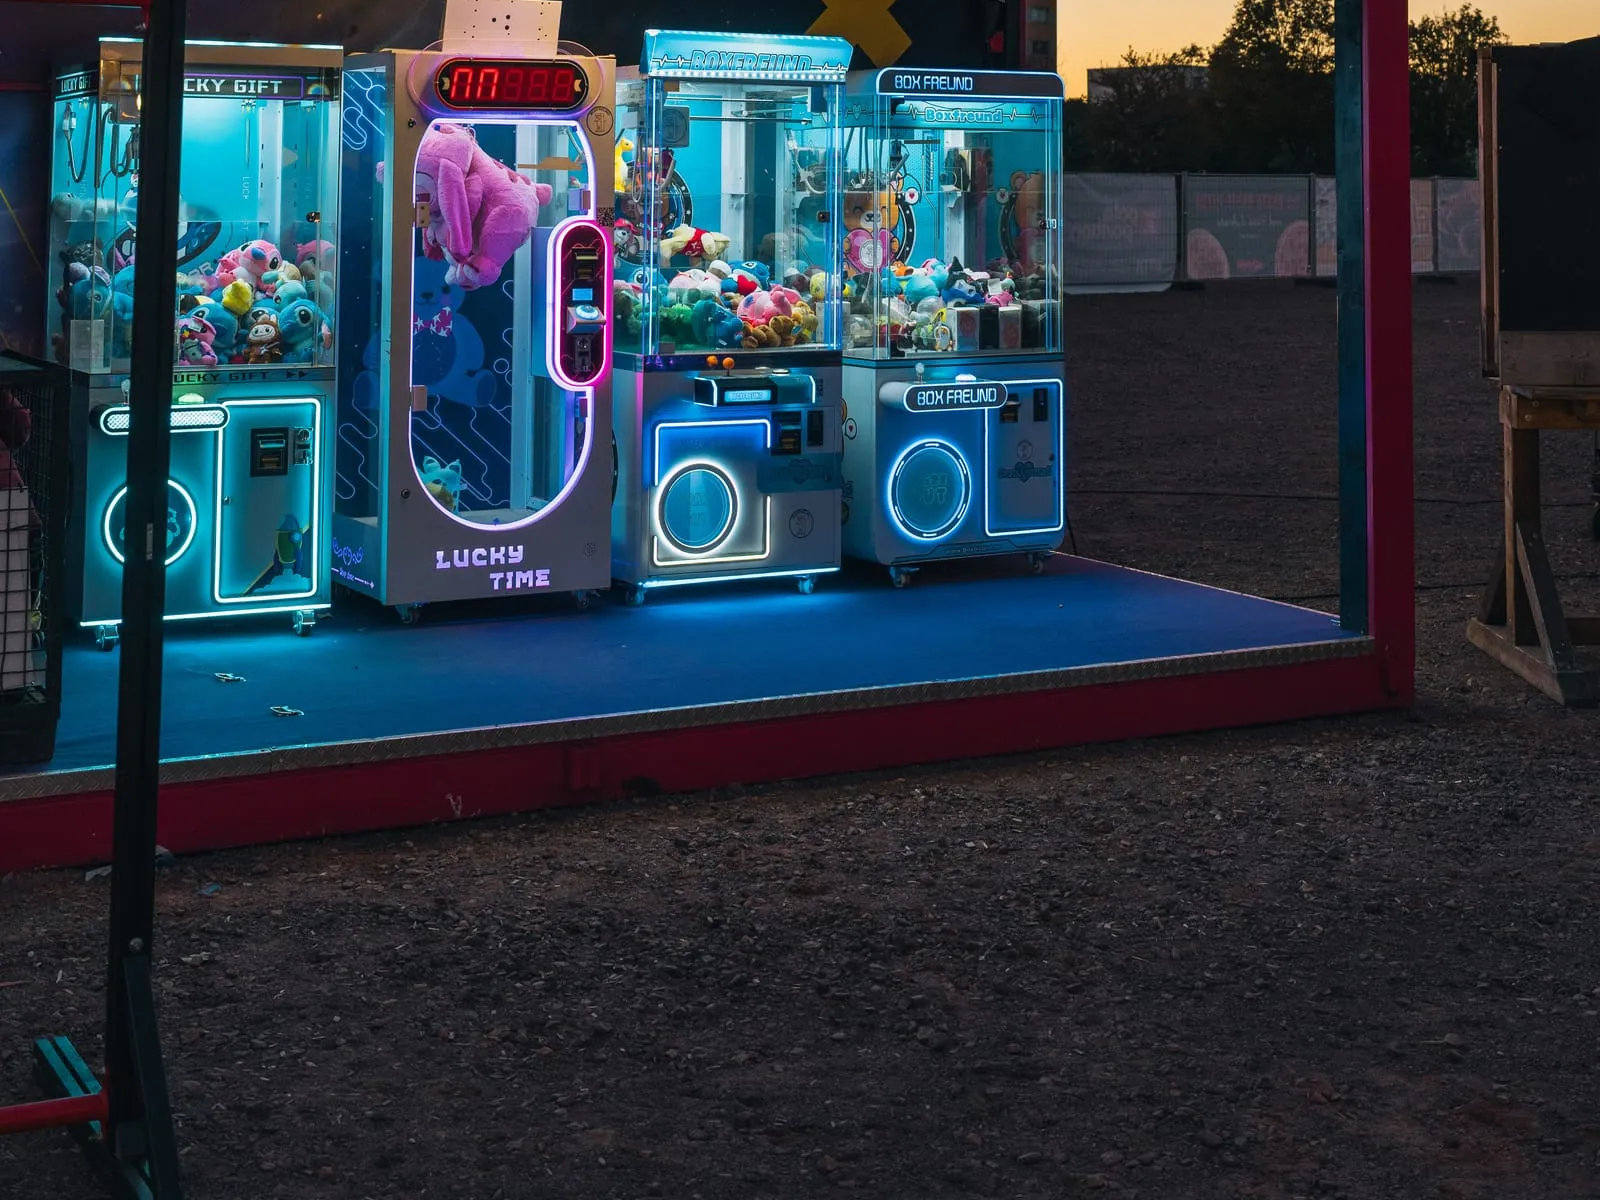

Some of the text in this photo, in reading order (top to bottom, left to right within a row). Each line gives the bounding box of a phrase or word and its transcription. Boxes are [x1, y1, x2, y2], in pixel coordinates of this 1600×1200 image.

[183, 78, 283, 94] CKY GIFT
[894, 75, 973, 91] BOX FREUND
[925, 107, 1003, 123] Boxfreund
[174, 371, 270, 383] UCKY GIFT
[917, 387, 997, 406] BOX FREUND
[436, 545, 524, 569] LUCKY
[489, 569, 550, 590] TIME
